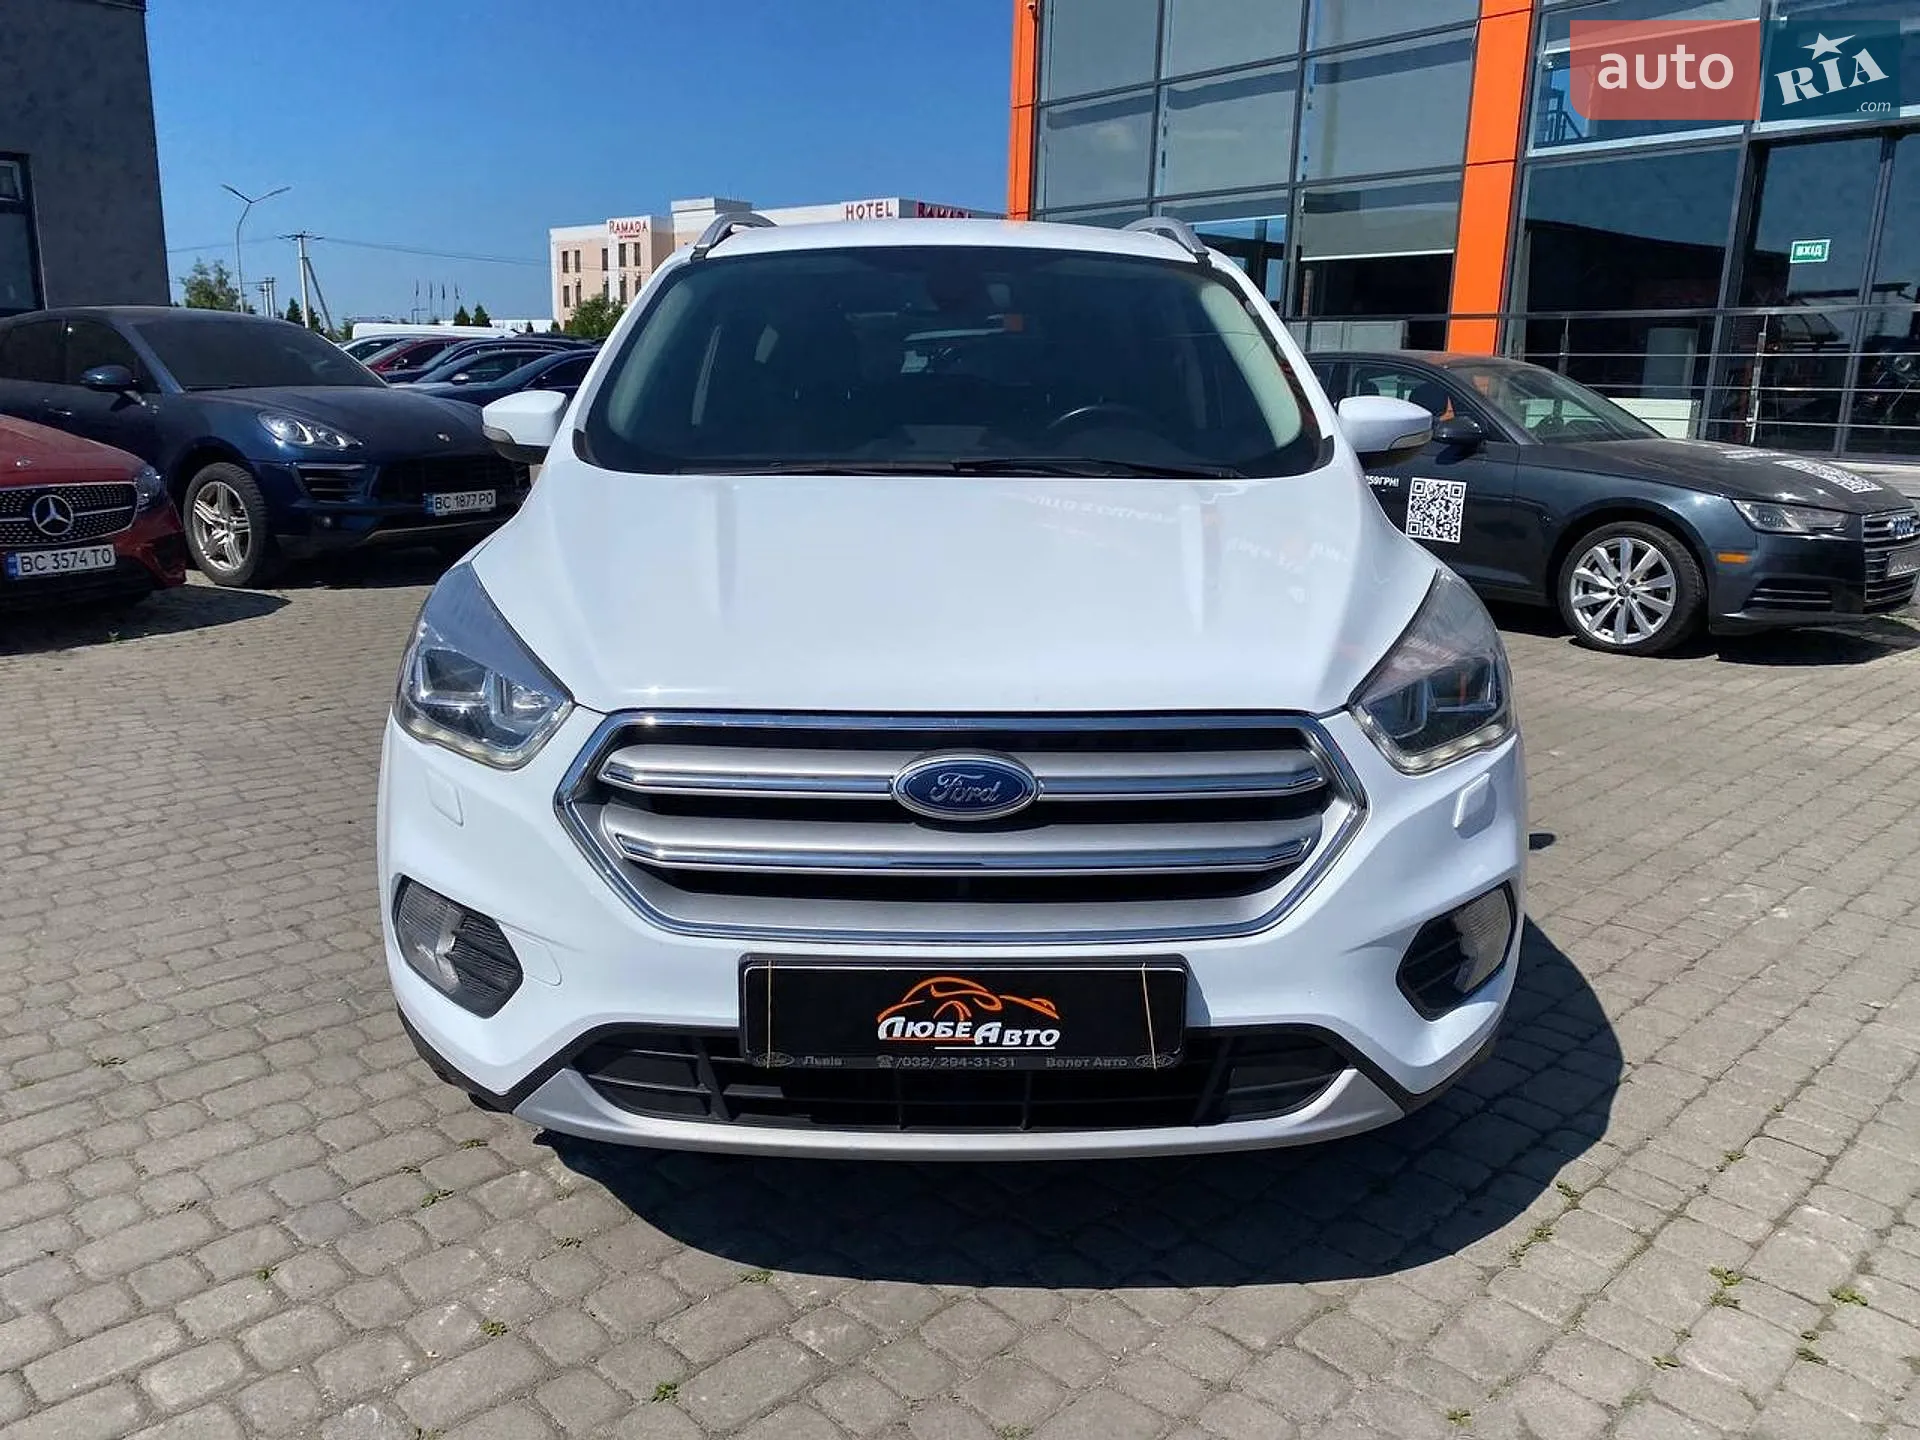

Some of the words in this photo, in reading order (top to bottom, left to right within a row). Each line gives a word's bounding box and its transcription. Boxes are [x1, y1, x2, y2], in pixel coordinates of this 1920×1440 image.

[845, 201, 893, 220] HOTEL
[608, 220, 649, 234] RAMADA
[1796, 244, 1823, 257] ВХІД
[50, 550, 88, 570] 3574
[929, 772, 1003, 803] Ford
